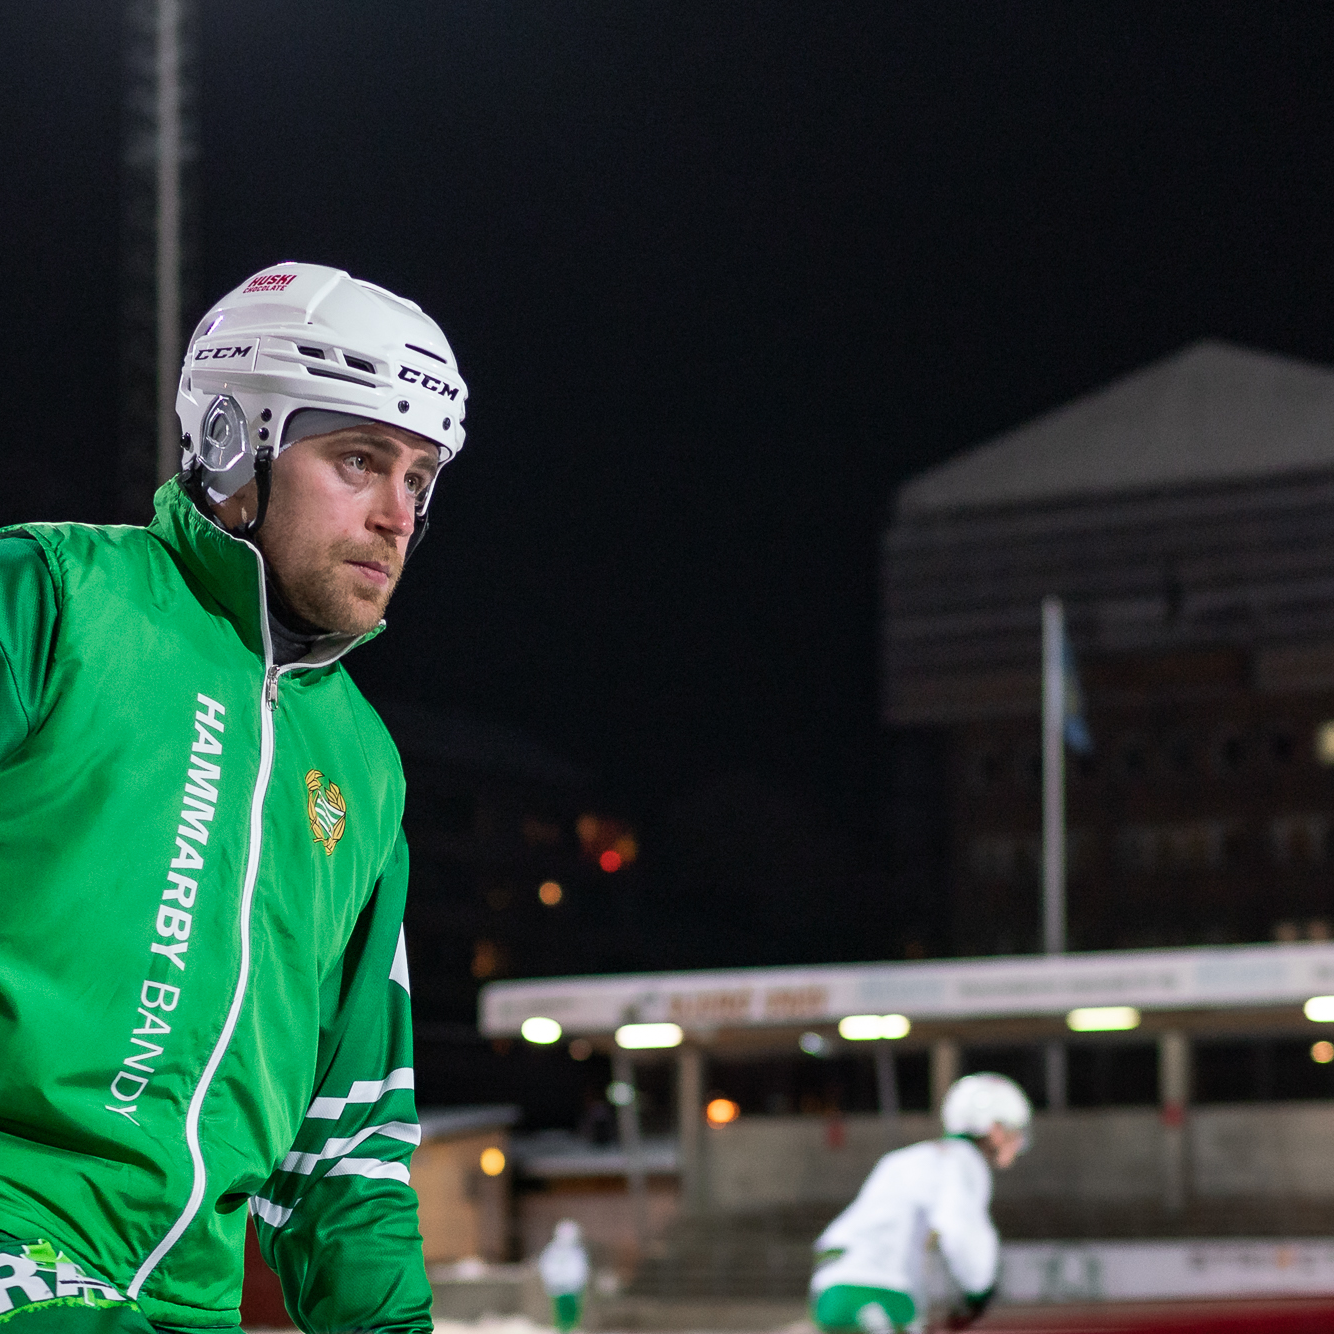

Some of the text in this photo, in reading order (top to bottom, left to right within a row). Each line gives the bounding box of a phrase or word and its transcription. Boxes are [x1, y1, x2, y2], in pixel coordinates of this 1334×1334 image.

[248, 275, 297, 287] HUSKI
[195, 346, 253, 361] CCM
[397, 364, 460, 402] CCM
[104, 692, 226, 1127] HAMMARBY BANDY
